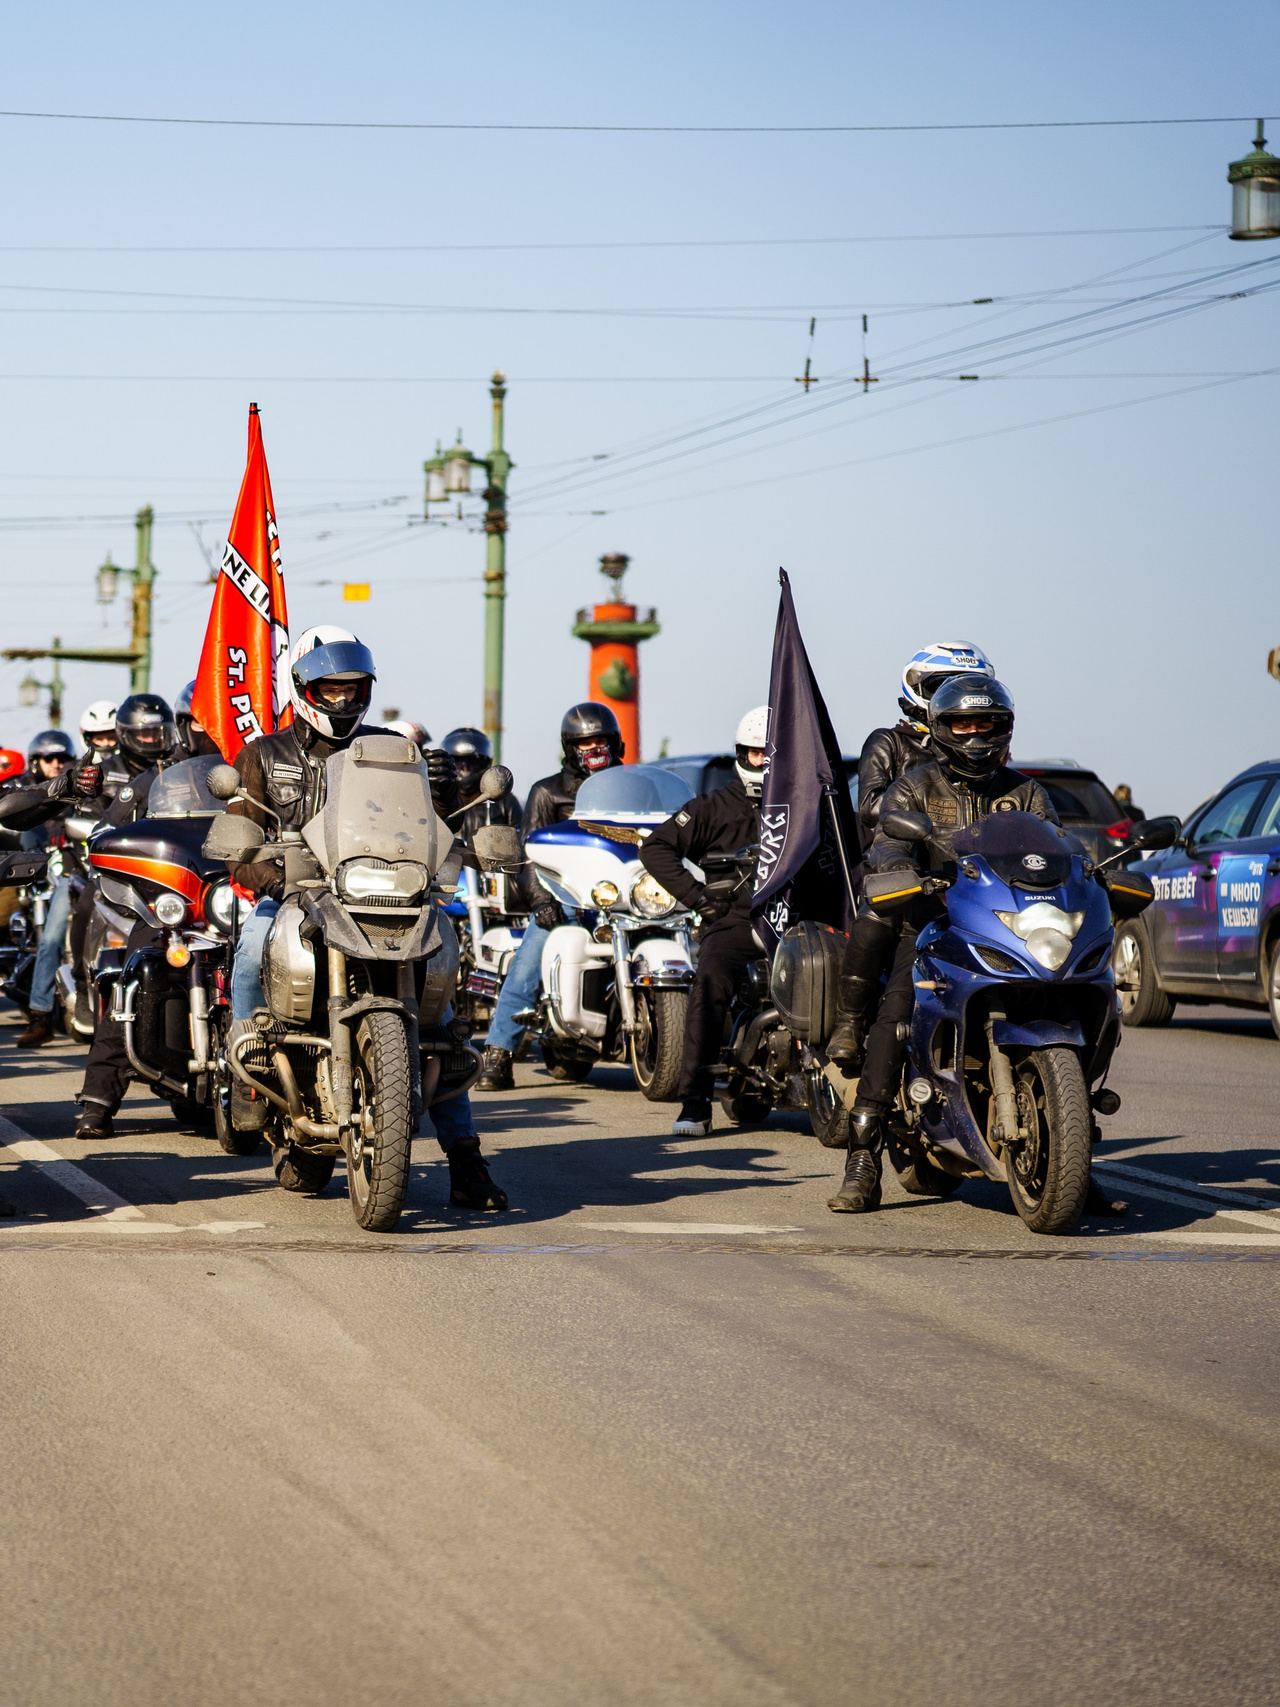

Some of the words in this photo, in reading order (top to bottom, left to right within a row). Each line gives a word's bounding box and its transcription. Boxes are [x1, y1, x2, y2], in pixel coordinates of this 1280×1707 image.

[955, 657, 977, 665] SHOEI
[965, 697, 990, 705] SHOEI
[1252, 863, 1264, 876] ВТБ
[1171, 871, 1197, 900] ВЕЗЁТ
[1231, 883, 1260, 902] МНОГО
